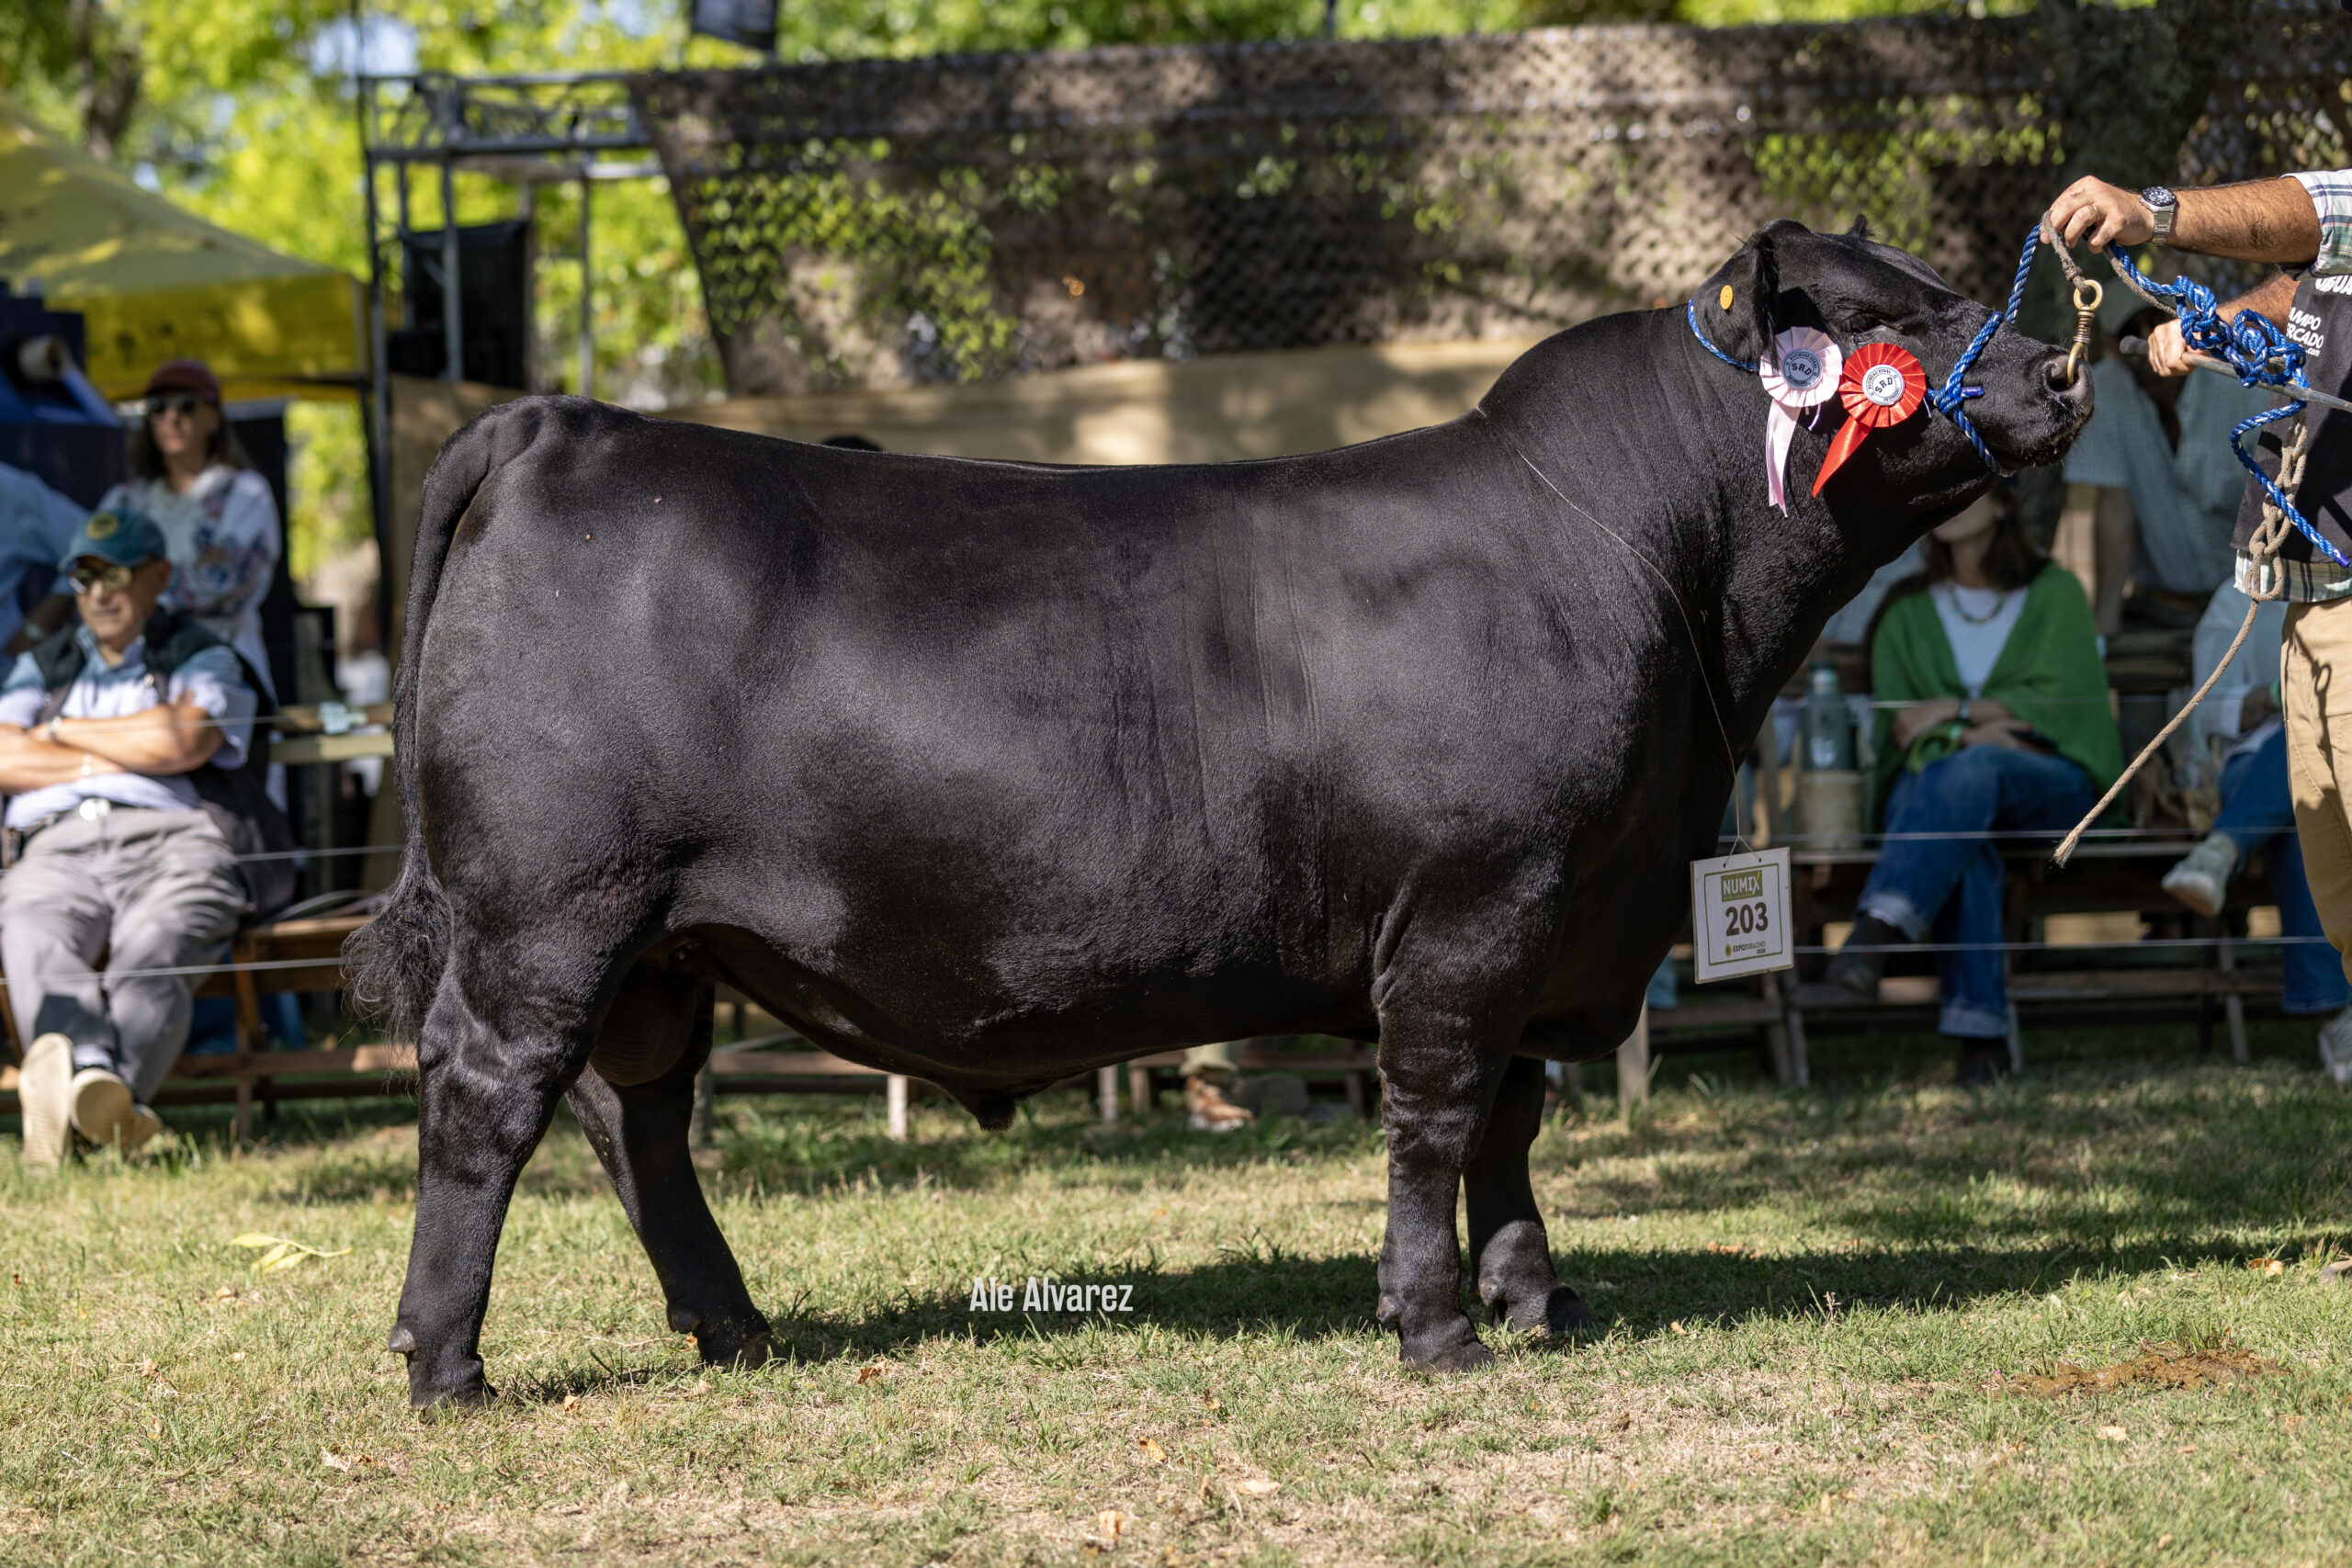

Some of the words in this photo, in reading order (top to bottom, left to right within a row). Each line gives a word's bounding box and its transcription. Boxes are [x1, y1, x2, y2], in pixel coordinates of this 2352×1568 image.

[1792, 362, 1813, 376] SRD
[1874, 377, 1894, 393] SRD
[1723, 872, 1761, 896] NUMIX
[1724, 901, 1769, 937] 203
